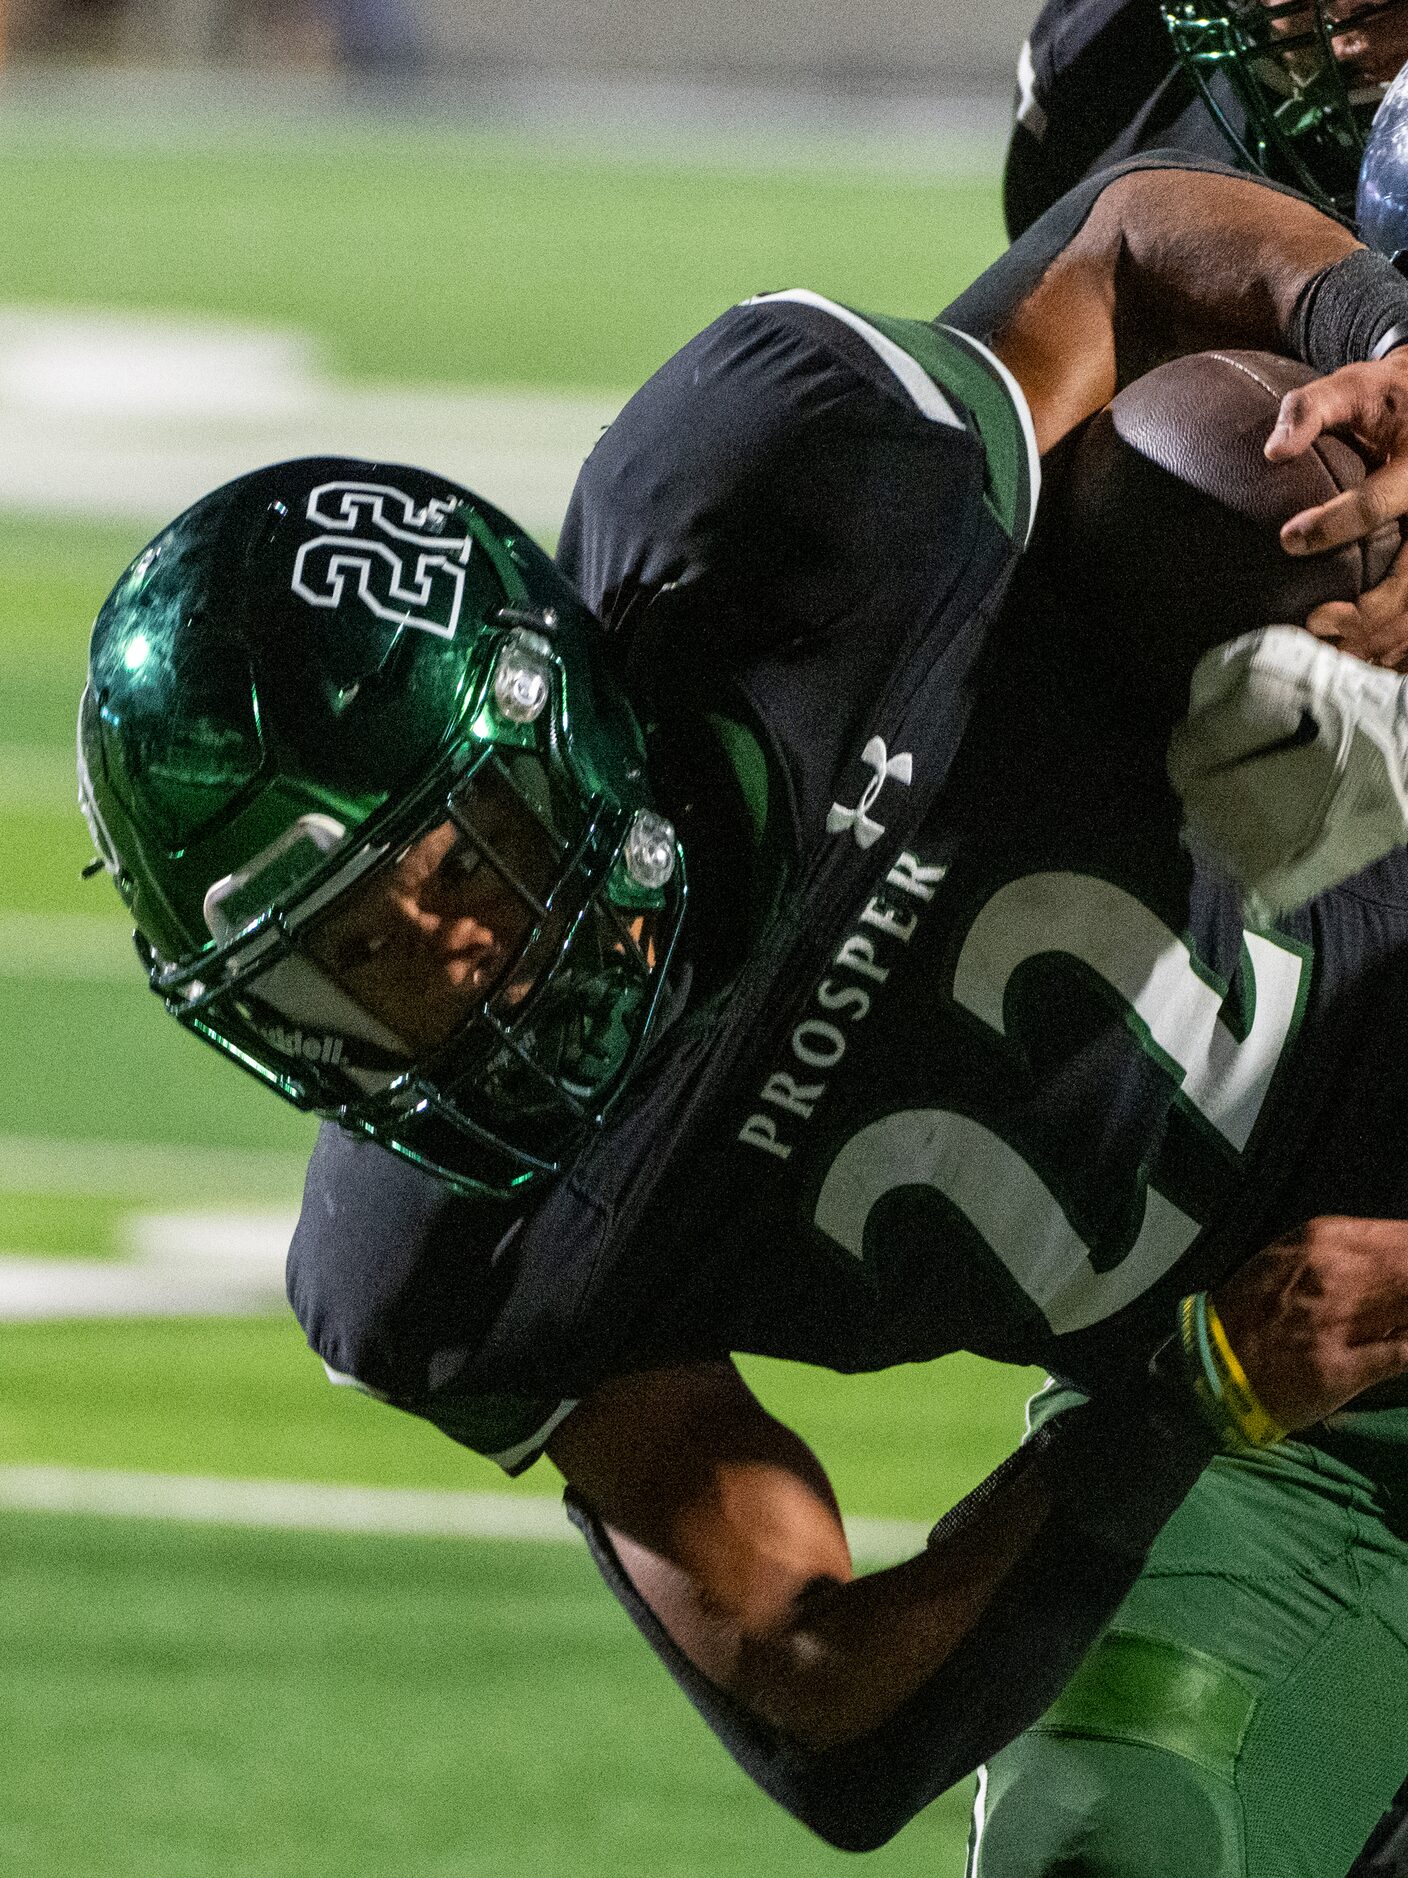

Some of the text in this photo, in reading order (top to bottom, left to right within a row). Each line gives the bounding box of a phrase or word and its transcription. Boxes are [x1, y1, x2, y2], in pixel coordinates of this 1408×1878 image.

[291, 480, 474, 640] 22
[738, 851, 947, 1160] PROSPER
[814, 871, 1312, 1335] 22
